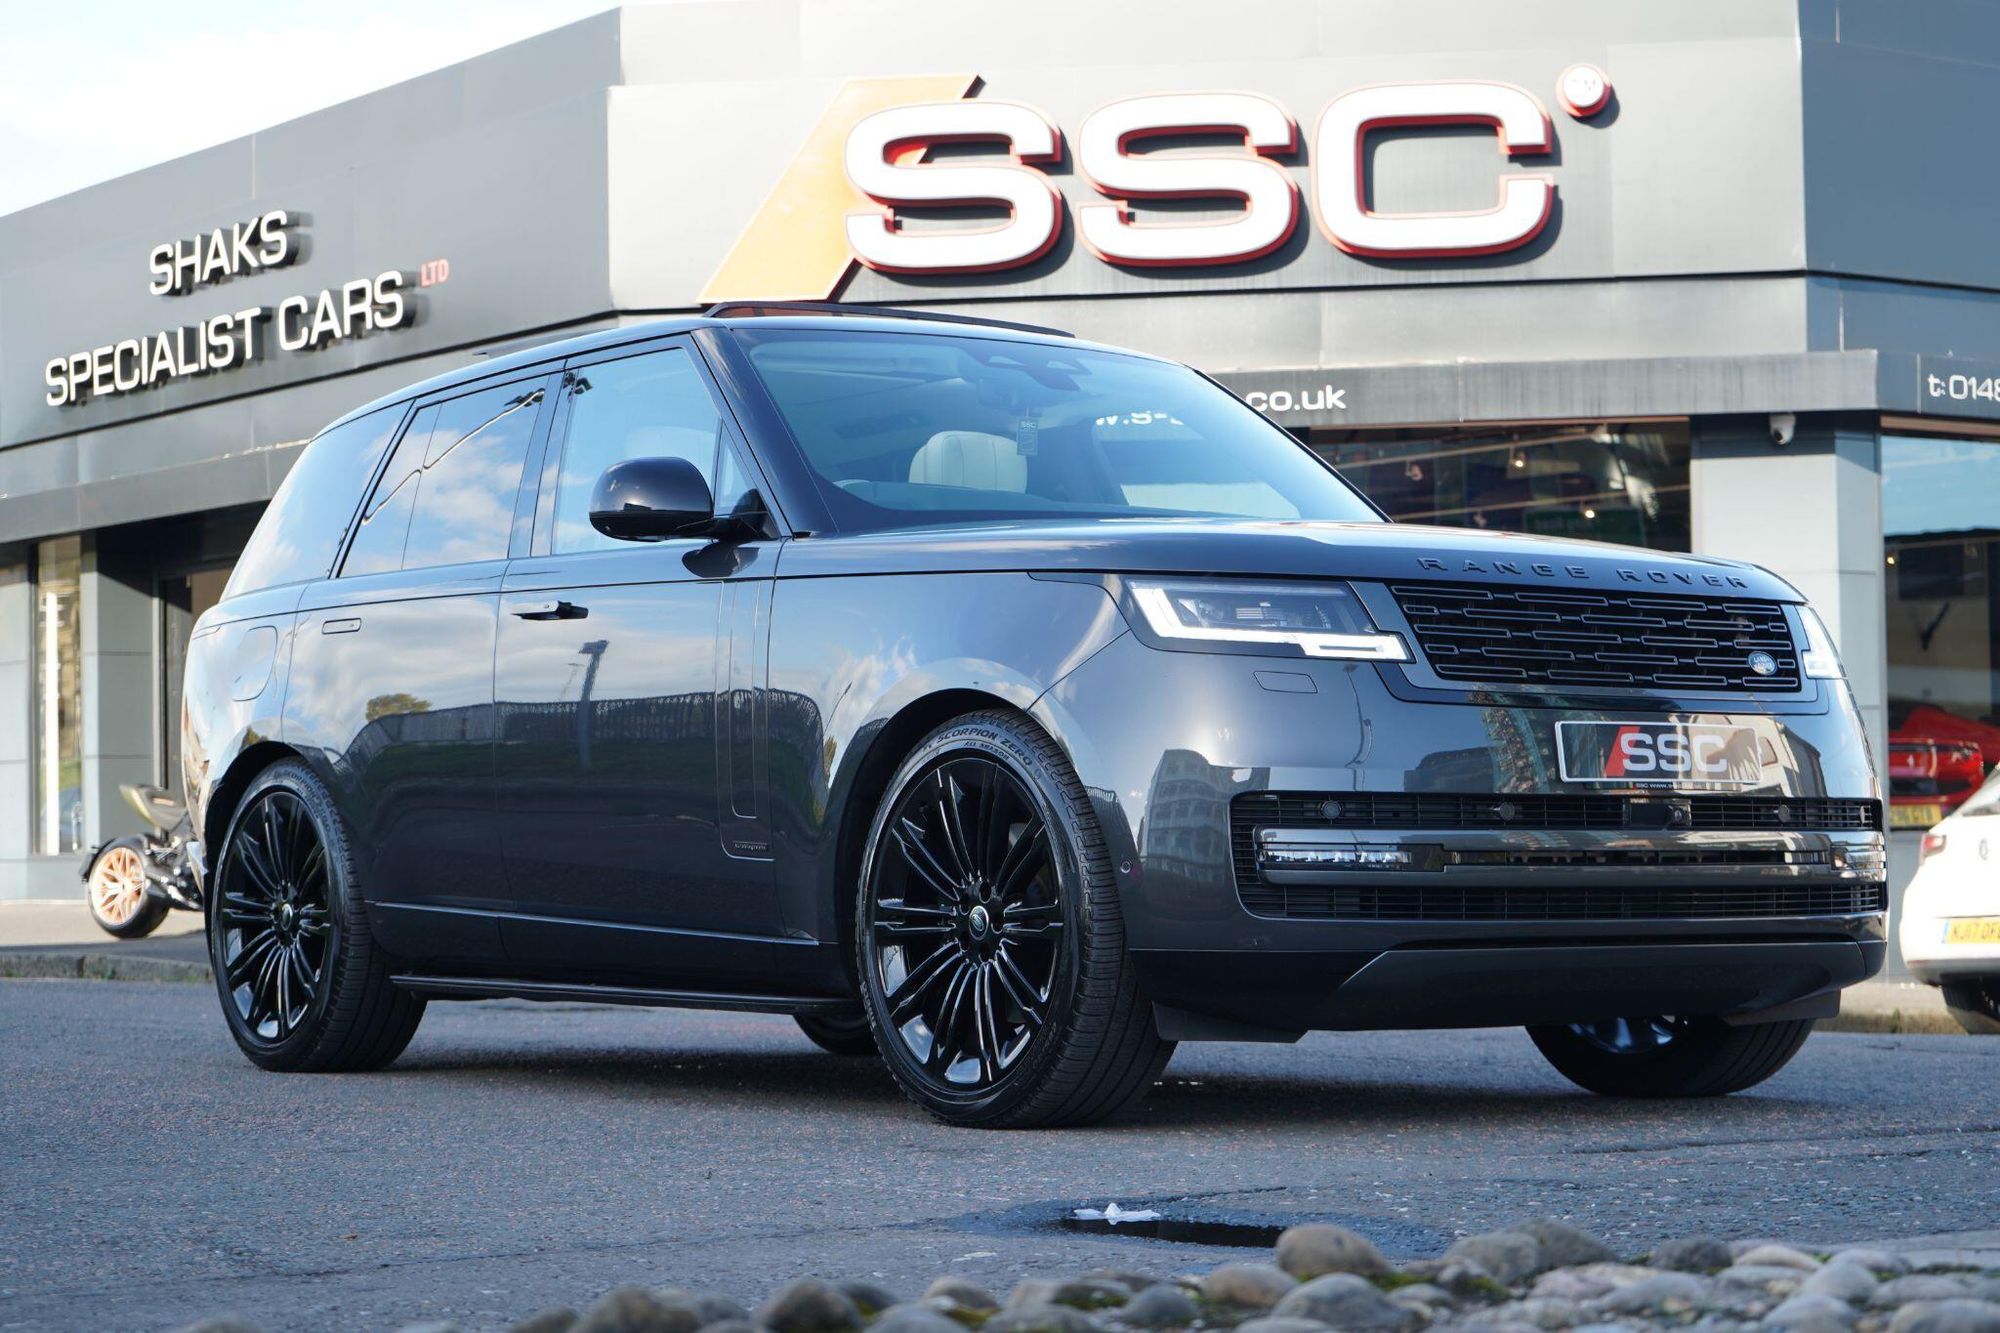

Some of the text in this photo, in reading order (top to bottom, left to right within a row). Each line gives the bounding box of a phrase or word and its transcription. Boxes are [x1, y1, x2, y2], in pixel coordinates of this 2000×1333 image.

[844, 79, 1553, 275] SSC
[150, 210, 288, 296] SHAKS
[45, 258, 450, 407] SPECIALIST CARS LTD
[1416, 556, 1750, 589] RANGE ROVER
[937, 728, 1033, 766] SCORPION ZERO
[1620, 732, 1728, 773] SSC
